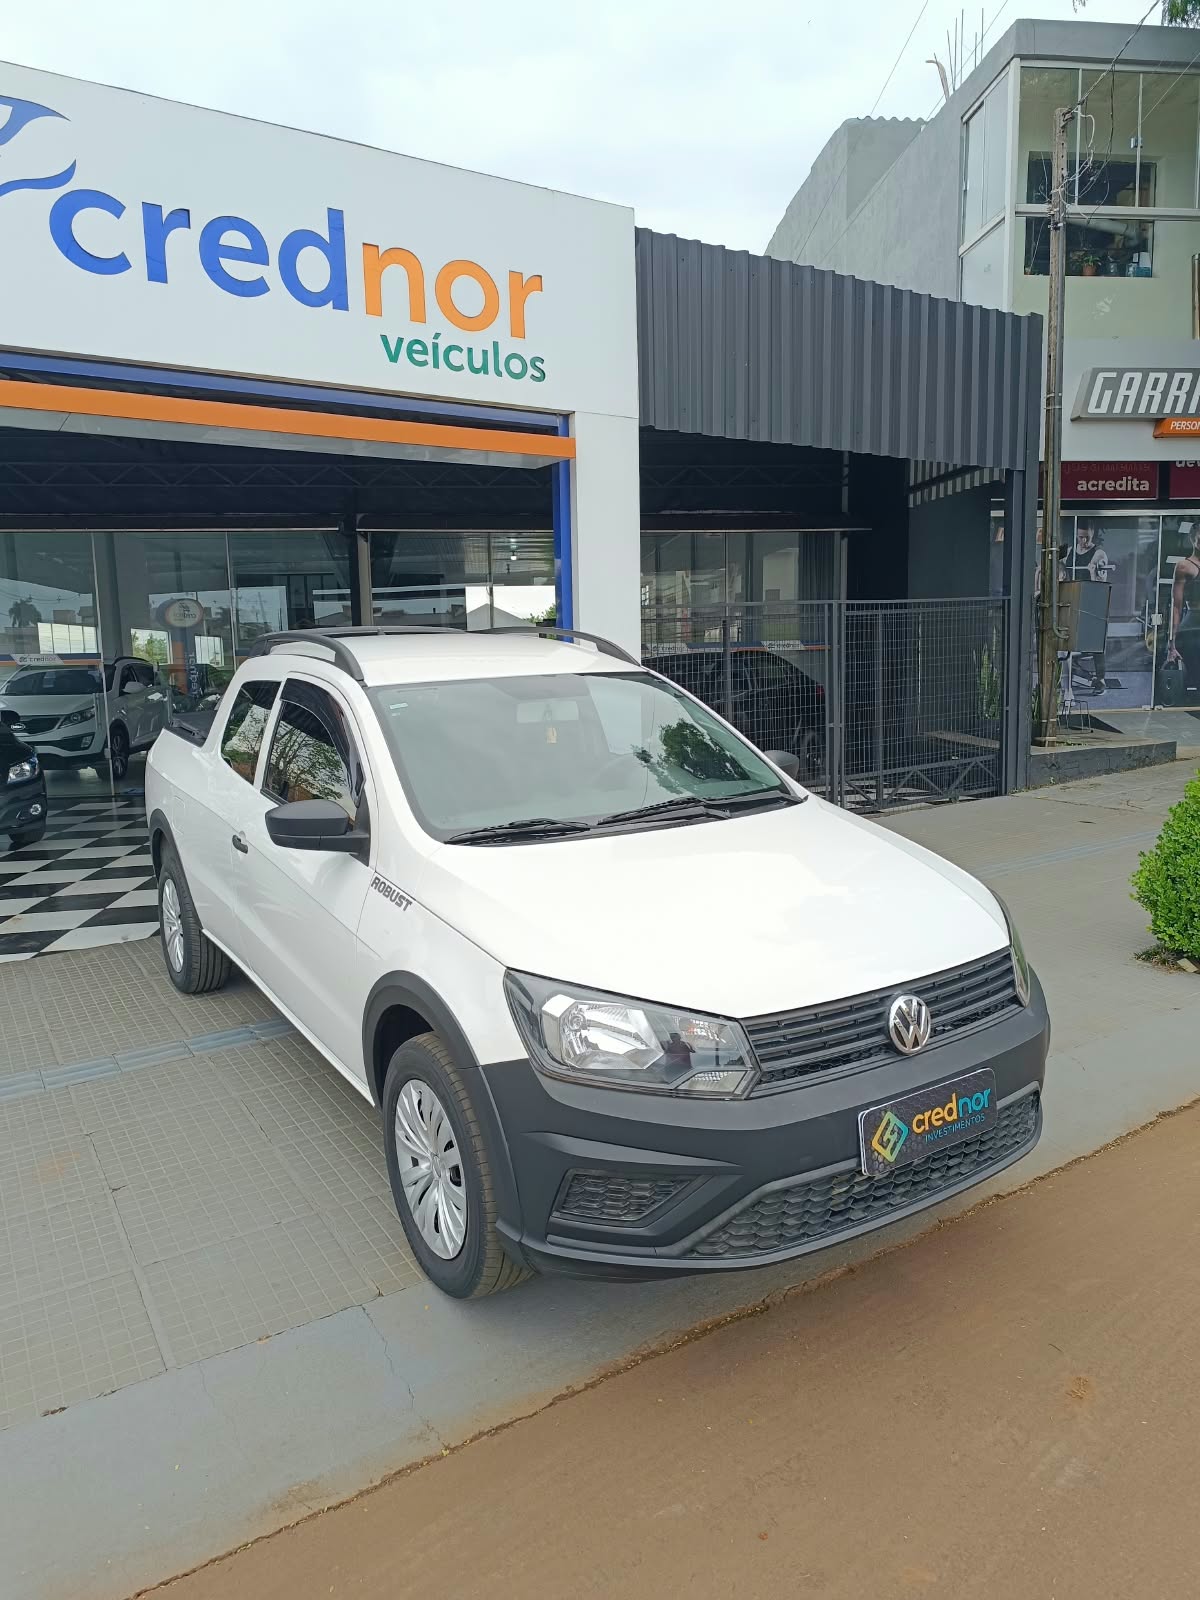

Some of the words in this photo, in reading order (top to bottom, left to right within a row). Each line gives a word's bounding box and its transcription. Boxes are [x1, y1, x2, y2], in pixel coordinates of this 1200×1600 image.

[49, 188, 544, 339] crednor
[379, 332, 547, 383] veículos
[1077, 476, 1150, 491] acredita
[371, 876, 413, 911] ROBUST
[912, 1088, 991, 1134] crednor
[924, 1113, 985, 1143] INVESTIMENTOS
